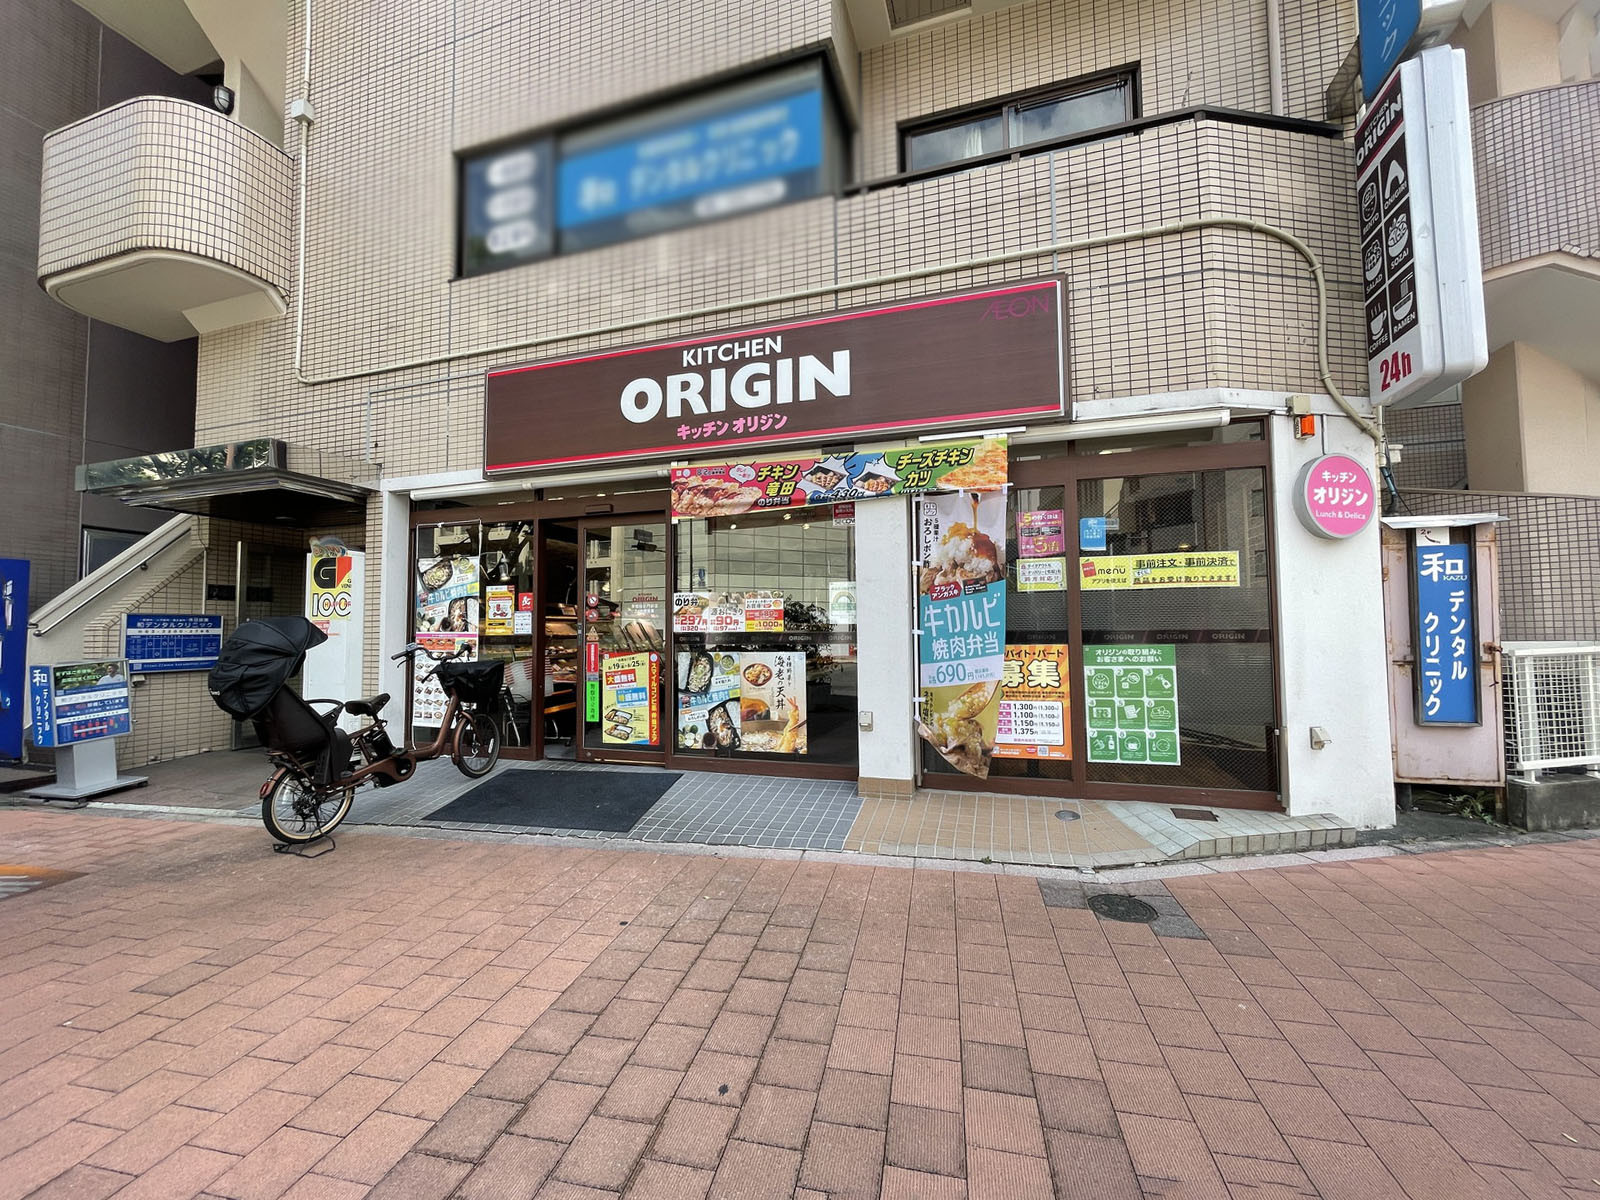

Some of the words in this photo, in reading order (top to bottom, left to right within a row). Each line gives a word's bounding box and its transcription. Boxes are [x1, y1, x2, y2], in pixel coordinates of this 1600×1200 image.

[1356, 93, 1402, 167] ORIGIN
[1364, 99, 1390, 138] KITCHEN
[1362, 212, 1380, 236] BENTO
[1366, 273, 1384, 294] SALAD
[1390, 247, 1410, 271] SOZAI
[1369, 332, 1389, 353] COFFEE
[1393, 311, 1416, 334] RAMEN
[682, 335, 782, 368] KITCHEN
[1379, 350, 1412, 392] 24h
[620, 349, 850, 424] ORIGIN
[677, 420, 729, 440] キッチン
[732, 413, 788, 433] オリジン
[897, 447, 975, 469] チーズチキン
[757, 464, 800, 482] チキン
[905, 469, 932, 487] カツ
[1321, 470, 1357, 483] キッチン
[757, 496, 791, 507] のり弁当
[766, 481, 796, 497] 竜田
[1313, 486, 1368, 506] オリジン
[1315, 509, 1337, 518] Lunch
[1337, 510, 1343, 518] &
[1344, 511, 1366, 520] Delica
[1135, 557, 1237, 568] 事前注文・事前決済で
[1420, 552, 1464, 583] 和
[674, 598, 698, 607] のり弁
[924, 592, 1001, 637] 牛カルビ
[680, 615, 707, 625] 297円
[932, 631, 999, 660] 焼肉弁当
[1212, 632, 1246, 640] ORIGIN
[1448, 590, 1468, 680] デンタル
[1004, 649, 1064, 658] バイト・パート
[1424, 612, 1442, 716] クリニック
[32, 669, 48, 686] 和
[774, 655, 786, 710] 海老の天丼
[1001, 659, 1061, 688] 募集
[35, 696, 43, 744] クリニック
